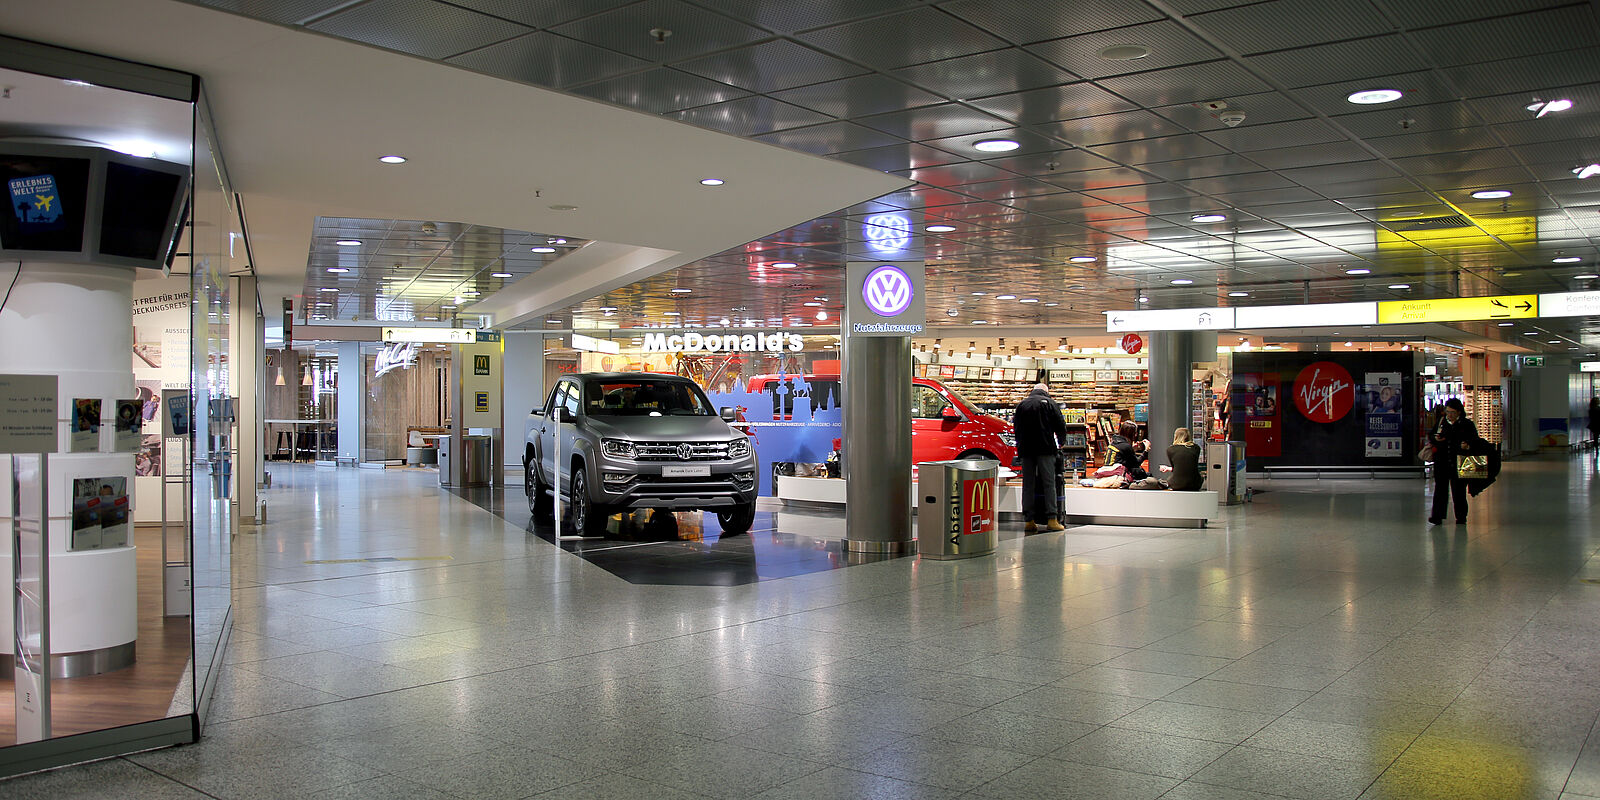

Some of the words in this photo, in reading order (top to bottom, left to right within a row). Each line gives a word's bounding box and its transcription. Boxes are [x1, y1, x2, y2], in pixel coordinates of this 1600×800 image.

[11, 177, 52, 189] ERLEBNIS
[13, 186, 35, 196] WELT
[140, 296, 158, 305] FREI
[158, 293, 173, 302] FÜR
[1401, 303, 1432, 311] Ankunft
[1401, 312, 1426, 320] Arrival
[853, 323, 922, 334] Nutzfahrzeuge
[642, 331, 804, 353] McDonald's
[1123, 335, 1140, 352] Virgin
[1096, 371, 1112, 380] GQ
[1300, 368, 1349, 416] Virgin
[950, 495, 960, 546] Abfall
